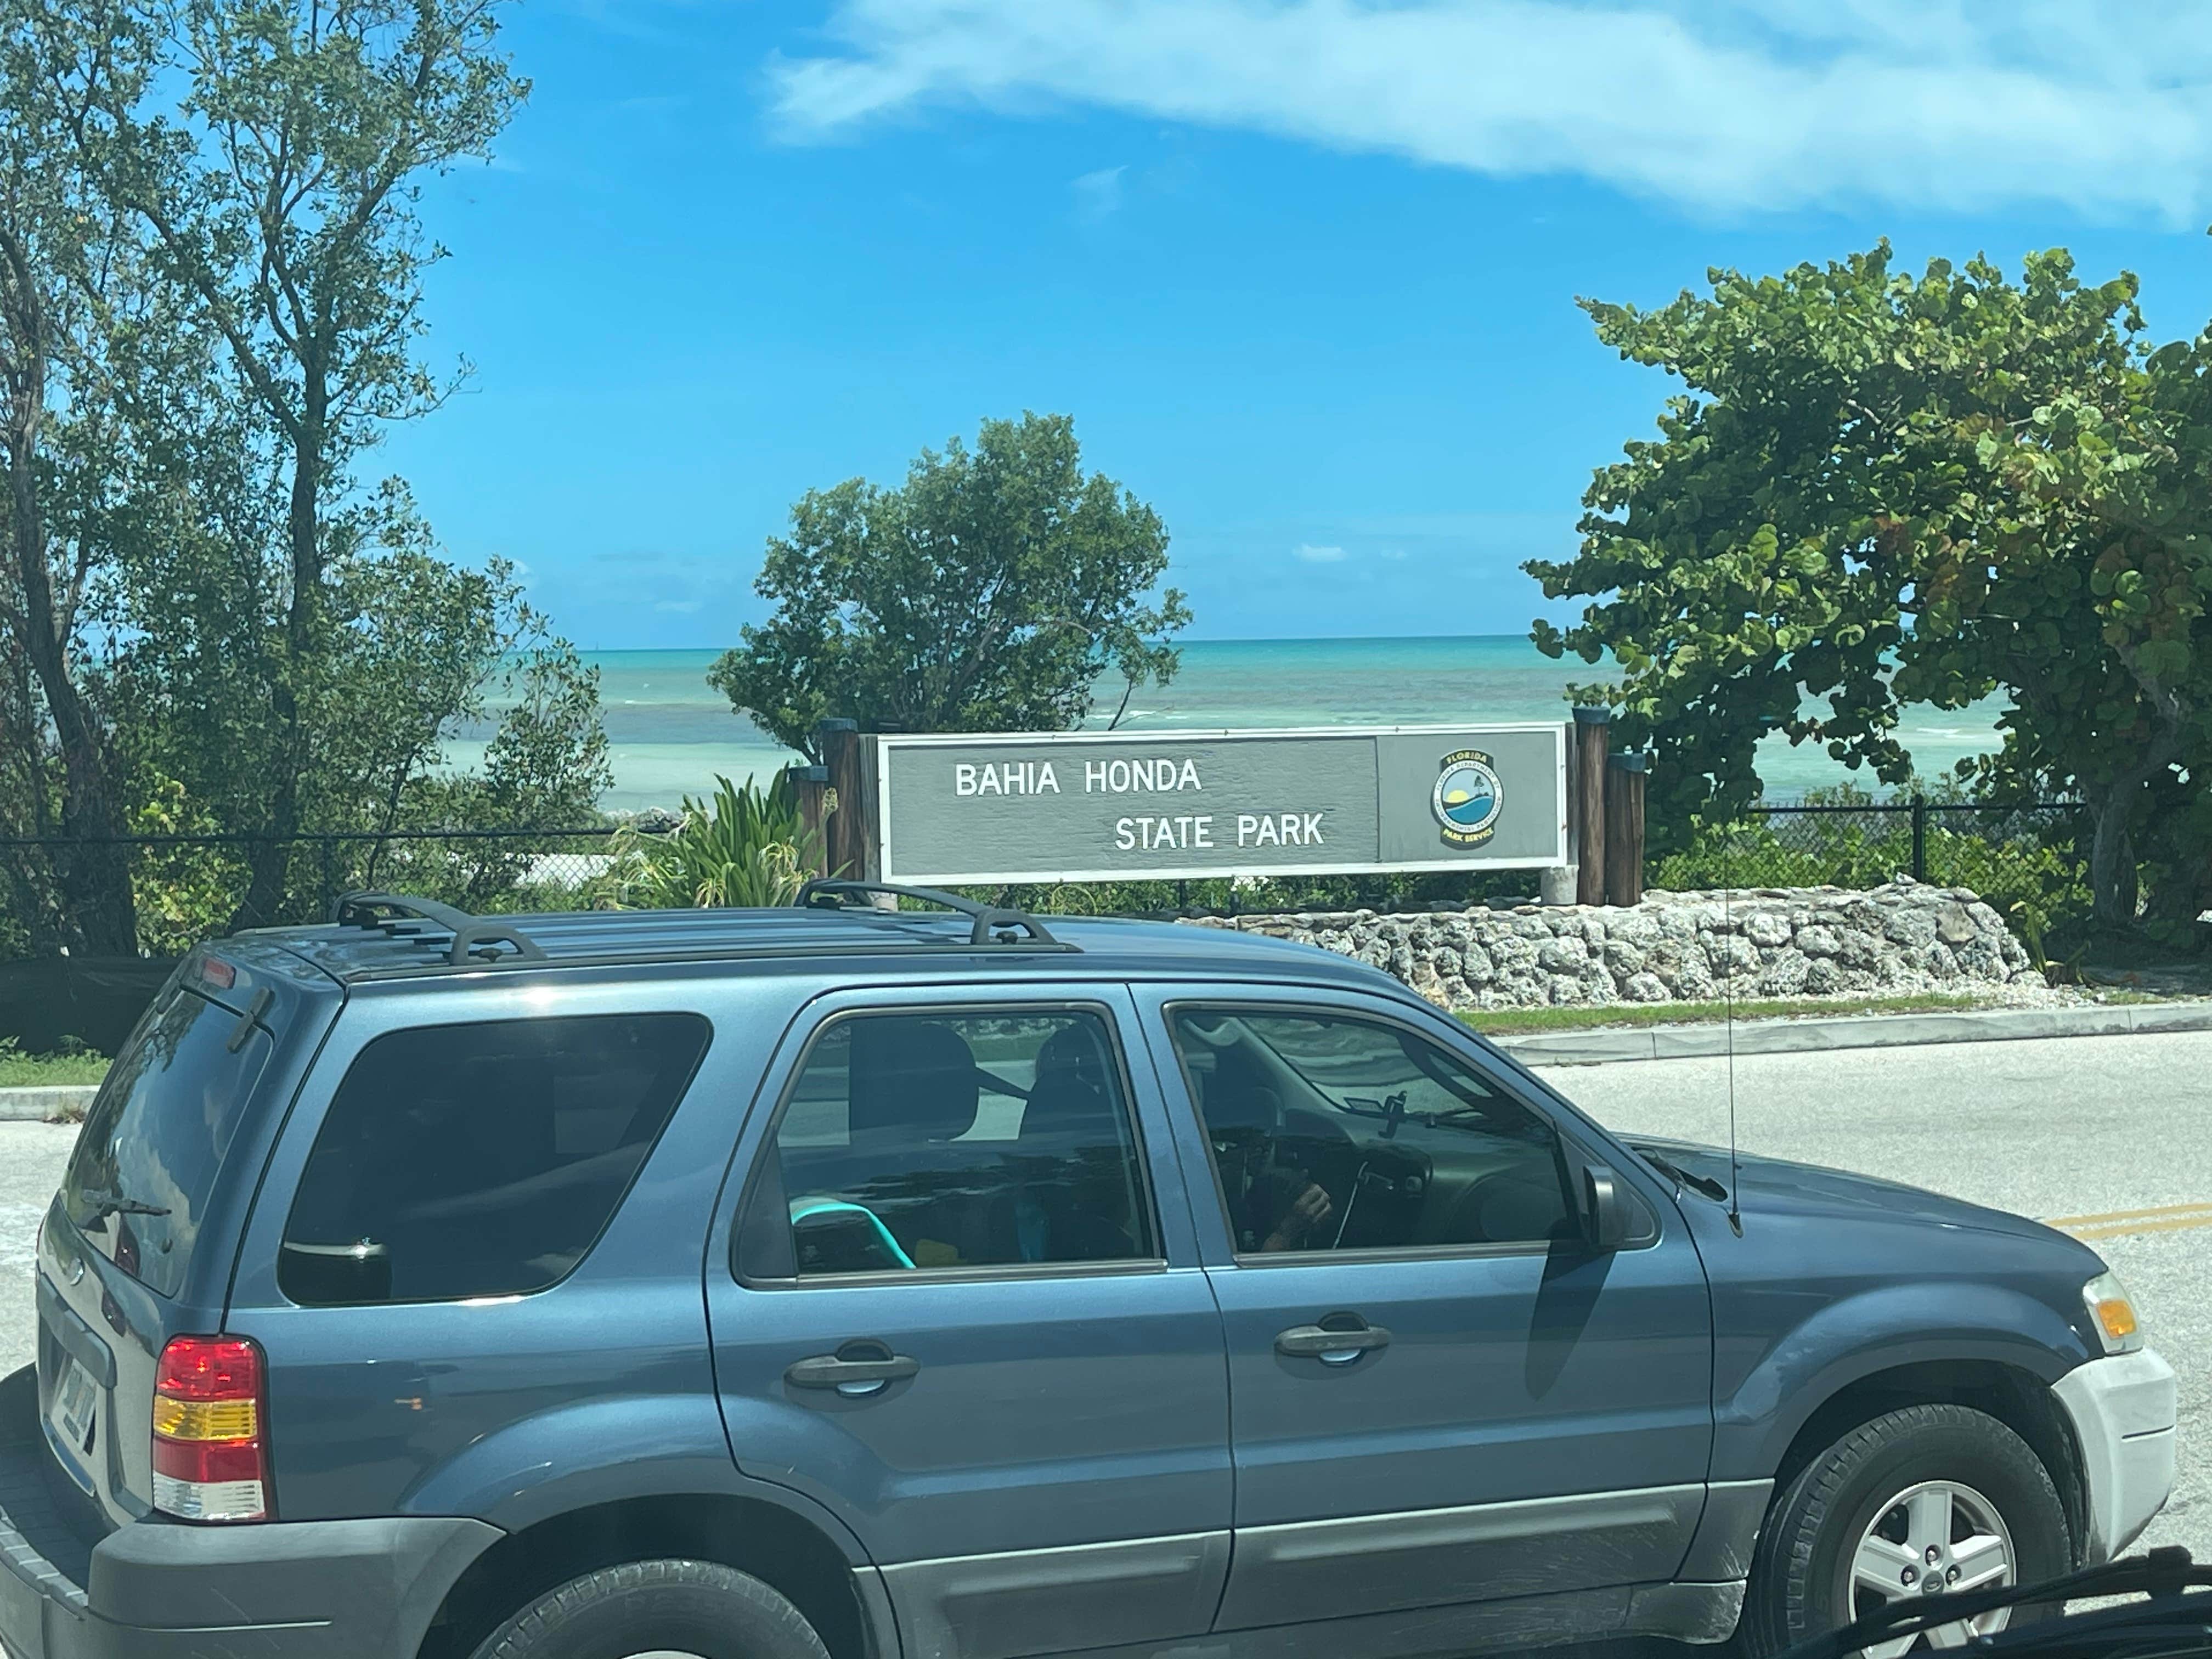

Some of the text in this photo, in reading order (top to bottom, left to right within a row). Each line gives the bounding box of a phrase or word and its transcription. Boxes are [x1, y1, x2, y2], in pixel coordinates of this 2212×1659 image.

[1446, 752, 1487, 764] FLORIDA
[955, 758, 1203, 796] BAHIA HONDA
[1115, 812, 1324, 850] STATE PARK
[1443, 827, 1494, 843] PARK SERVICE
